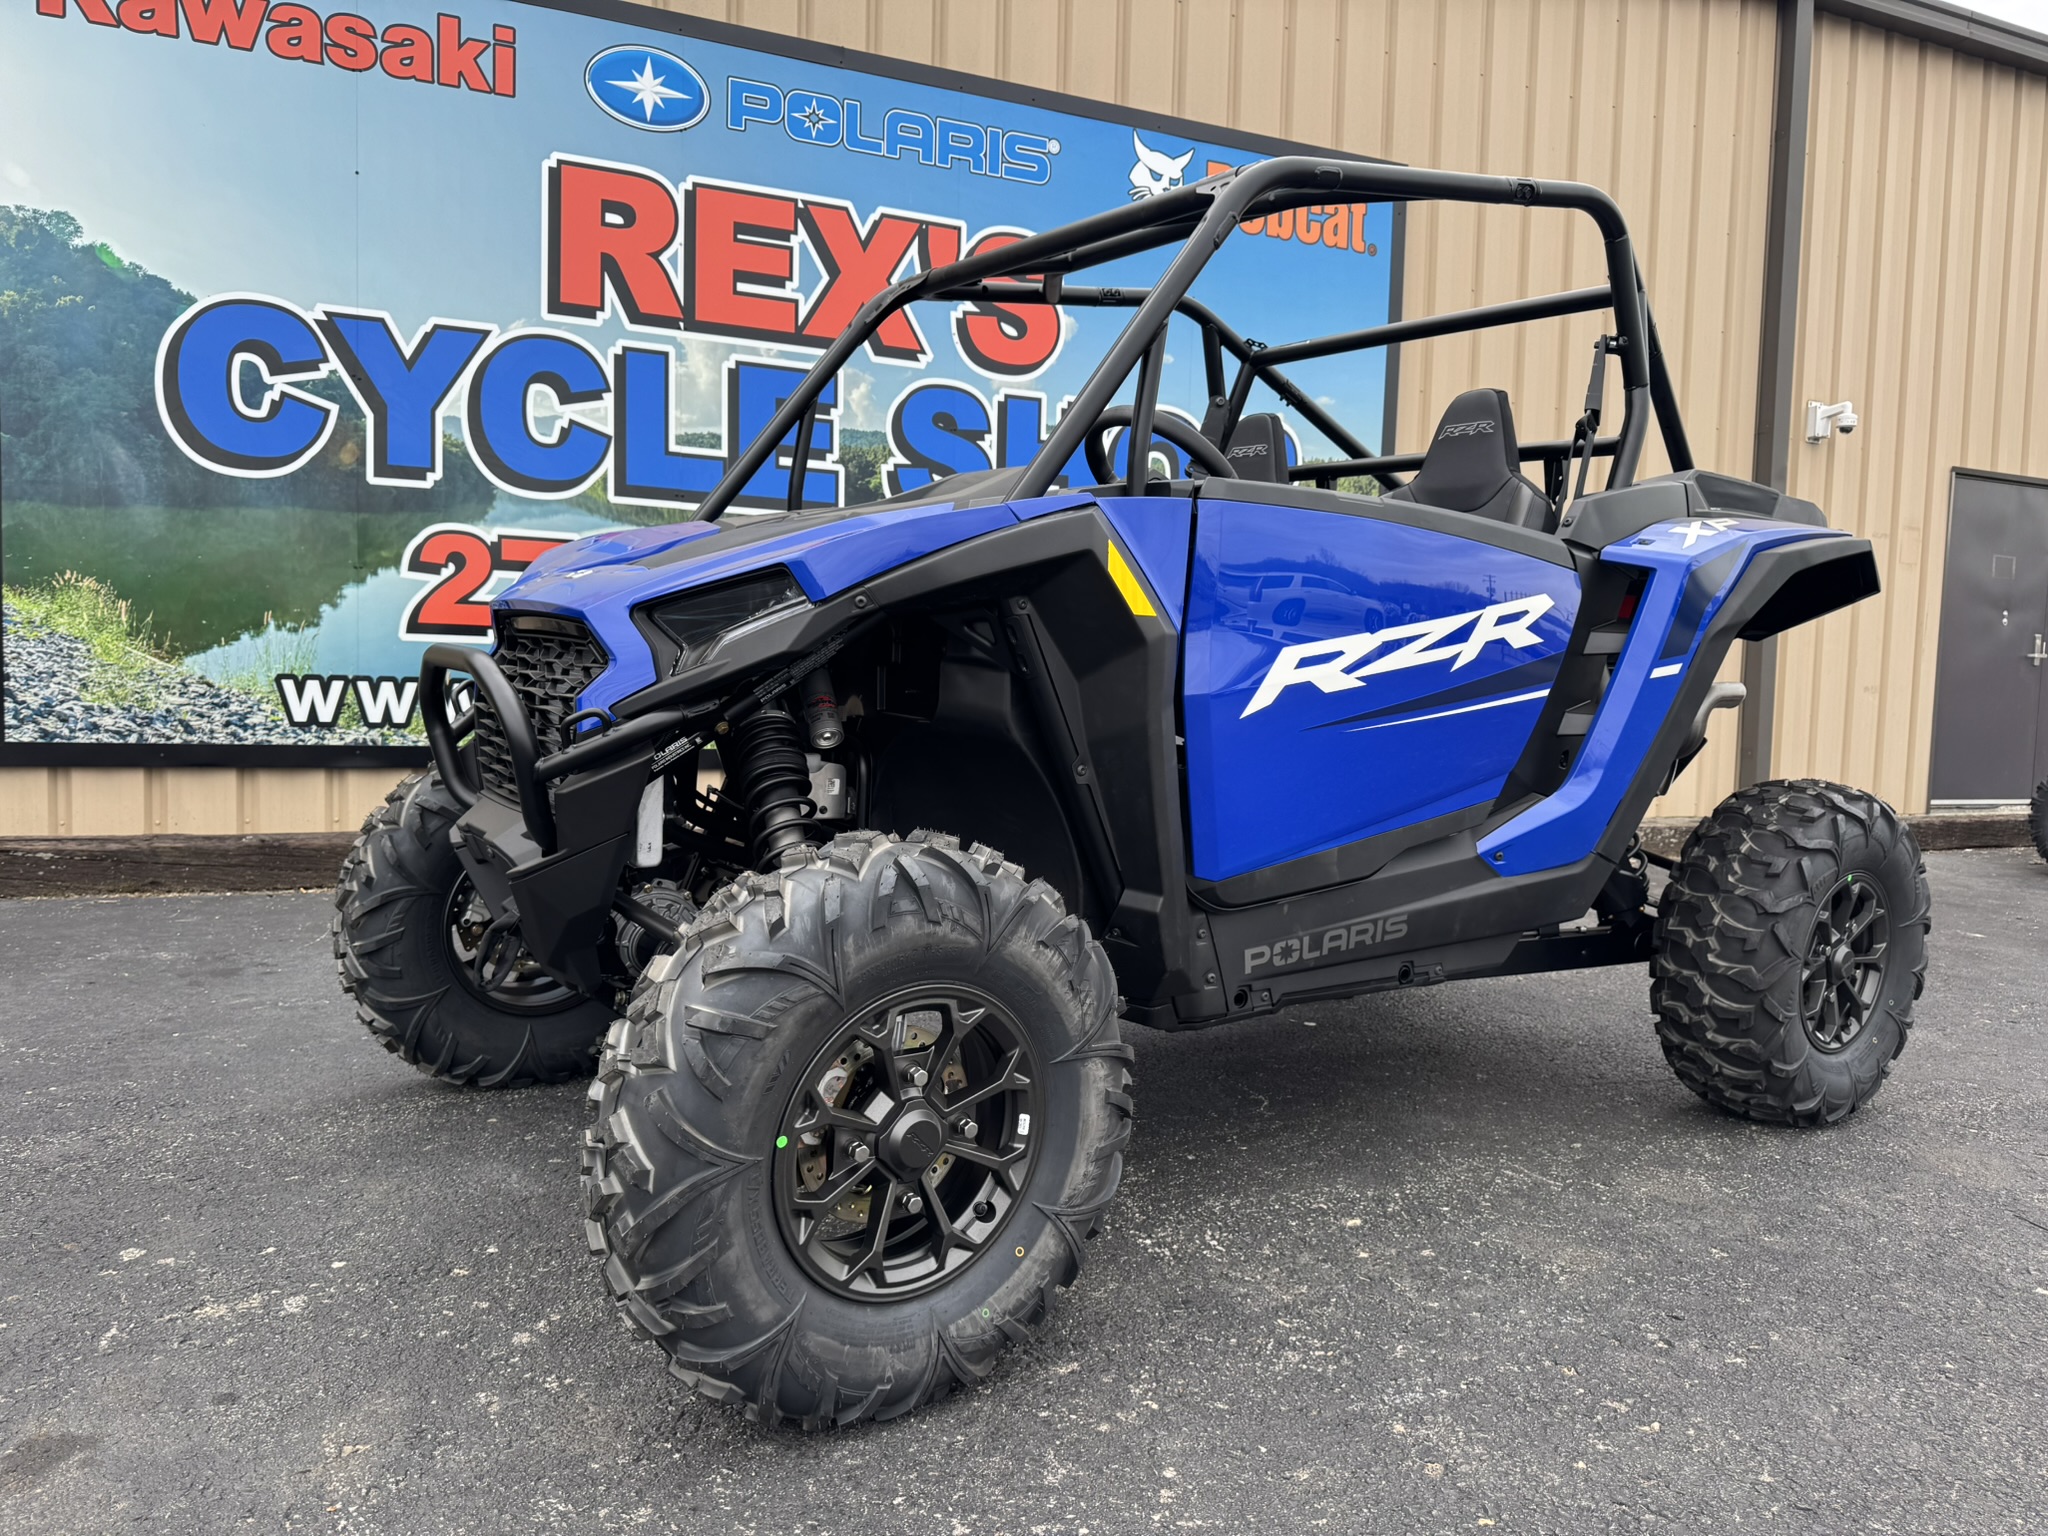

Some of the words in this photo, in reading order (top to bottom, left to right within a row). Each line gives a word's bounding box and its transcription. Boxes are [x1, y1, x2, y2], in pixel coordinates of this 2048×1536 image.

[543, 153, 1067, 378] REX'S
[158, 293, 846, 508] CYCLE
[885, 378, 1302, 500] SHO
[1437, 420, 1495, 440] RZR
[1226, 444, 1268, 459] RZR
[1667, 518, 1740, 550] XP
[1239, 593, 1556, 720] RZR
[1244, 914, 1408, 975] POLARIS
